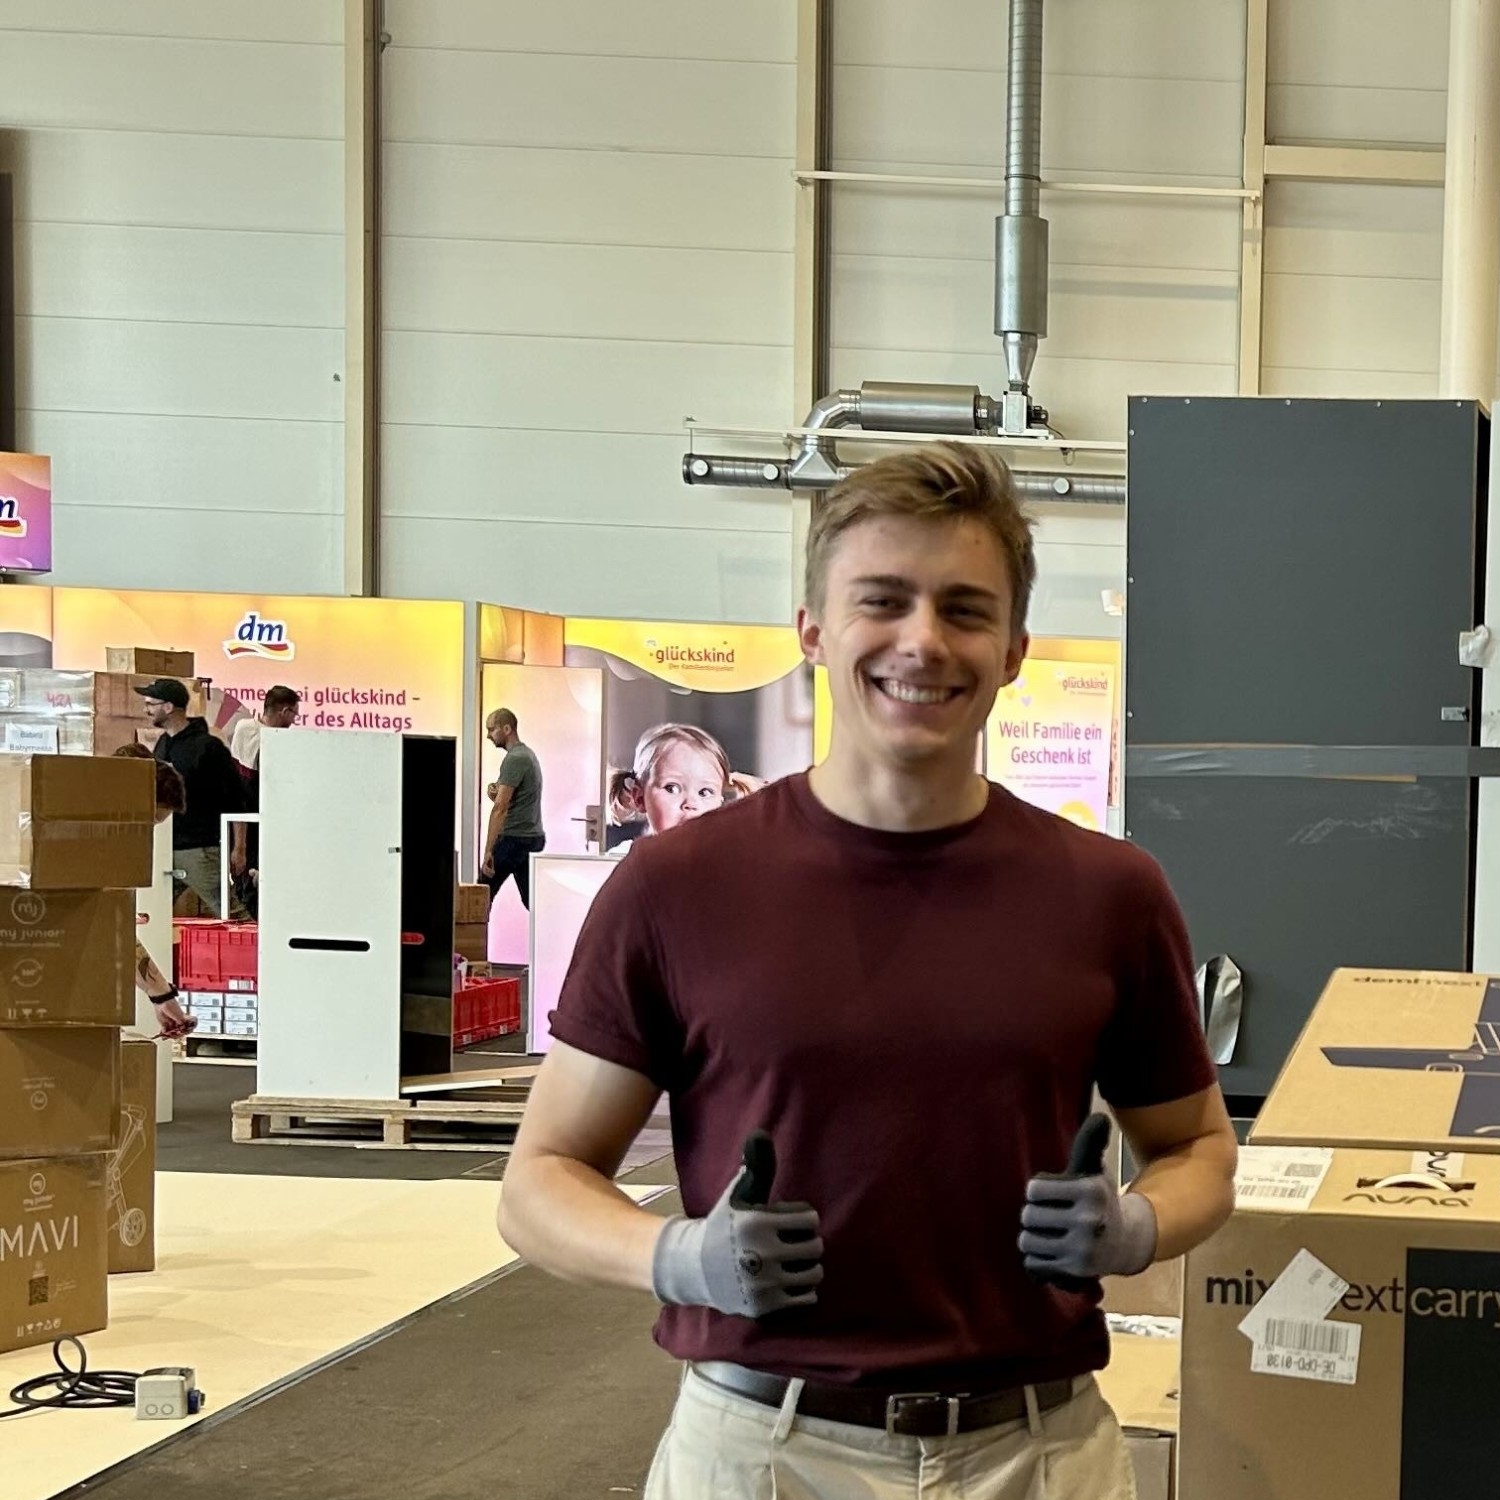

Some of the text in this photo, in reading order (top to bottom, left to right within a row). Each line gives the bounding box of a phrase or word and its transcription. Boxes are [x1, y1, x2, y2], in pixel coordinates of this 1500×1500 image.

[238, 615, 284, 641] dm
[656, 645, 735, 663] glückskind
[314, 686, 407, 706] glückskind
[315, 711, 345, 728] des
[350, 713, 412, 733] Alltags
[999, 721, 1102, 741] Weil Familie ein
[1011, 746, 1092, 766] Geschenk ist
[1342, 1193, 1469, 1208] nuna
[0, 1215, 78, 1262] MAVI
